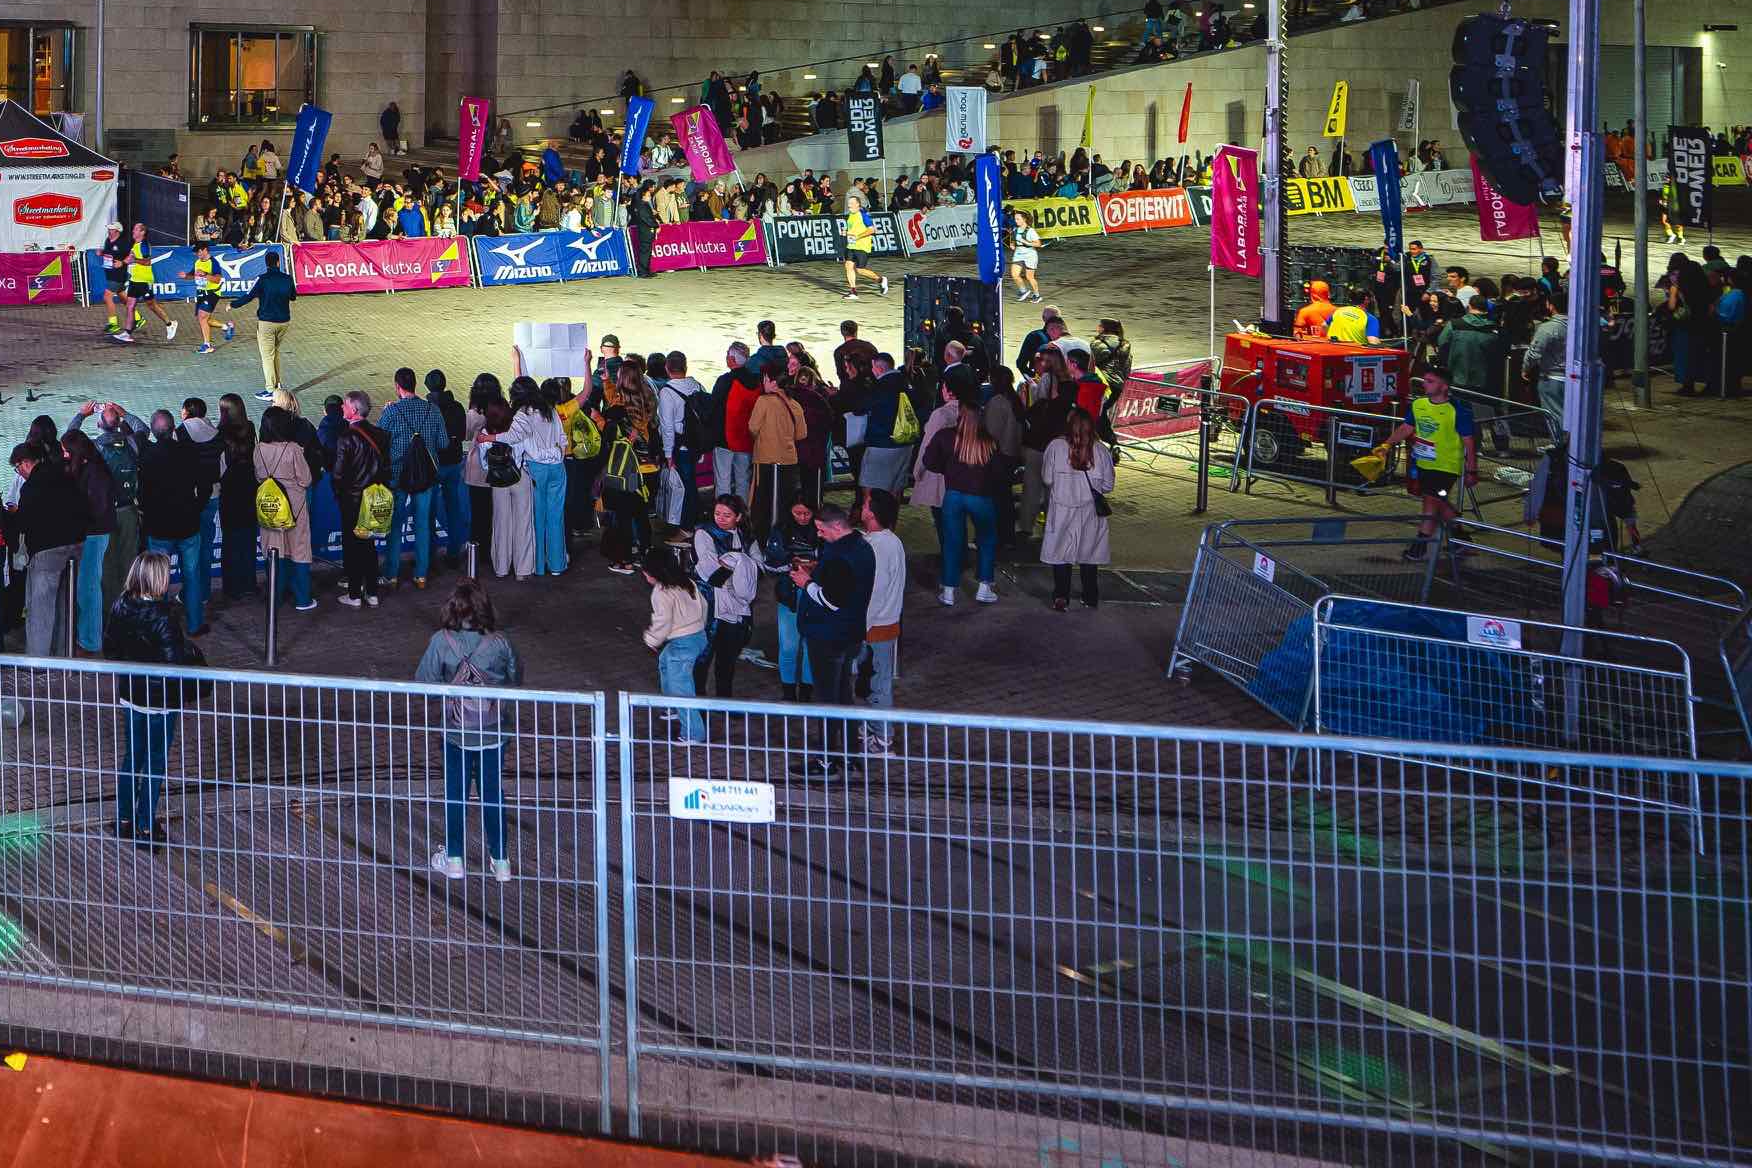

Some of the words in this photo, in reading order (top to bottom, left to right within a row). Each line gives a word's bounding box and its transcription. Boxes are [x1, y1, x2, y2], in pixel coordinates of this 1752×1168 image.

[1307, 180, 1344, 208] BM
[1127, 195, 1185, 222] ENERVIT
[777, 218, 832, 238] POWER
[651, 242, 693, 258] ABORAL
[696, 240, 726, 253] kutxa
[804, 237, 835, 256] ADE
[305, 262, 377, 279] LABORAL
[382, 259, 422, 275] kutxa
